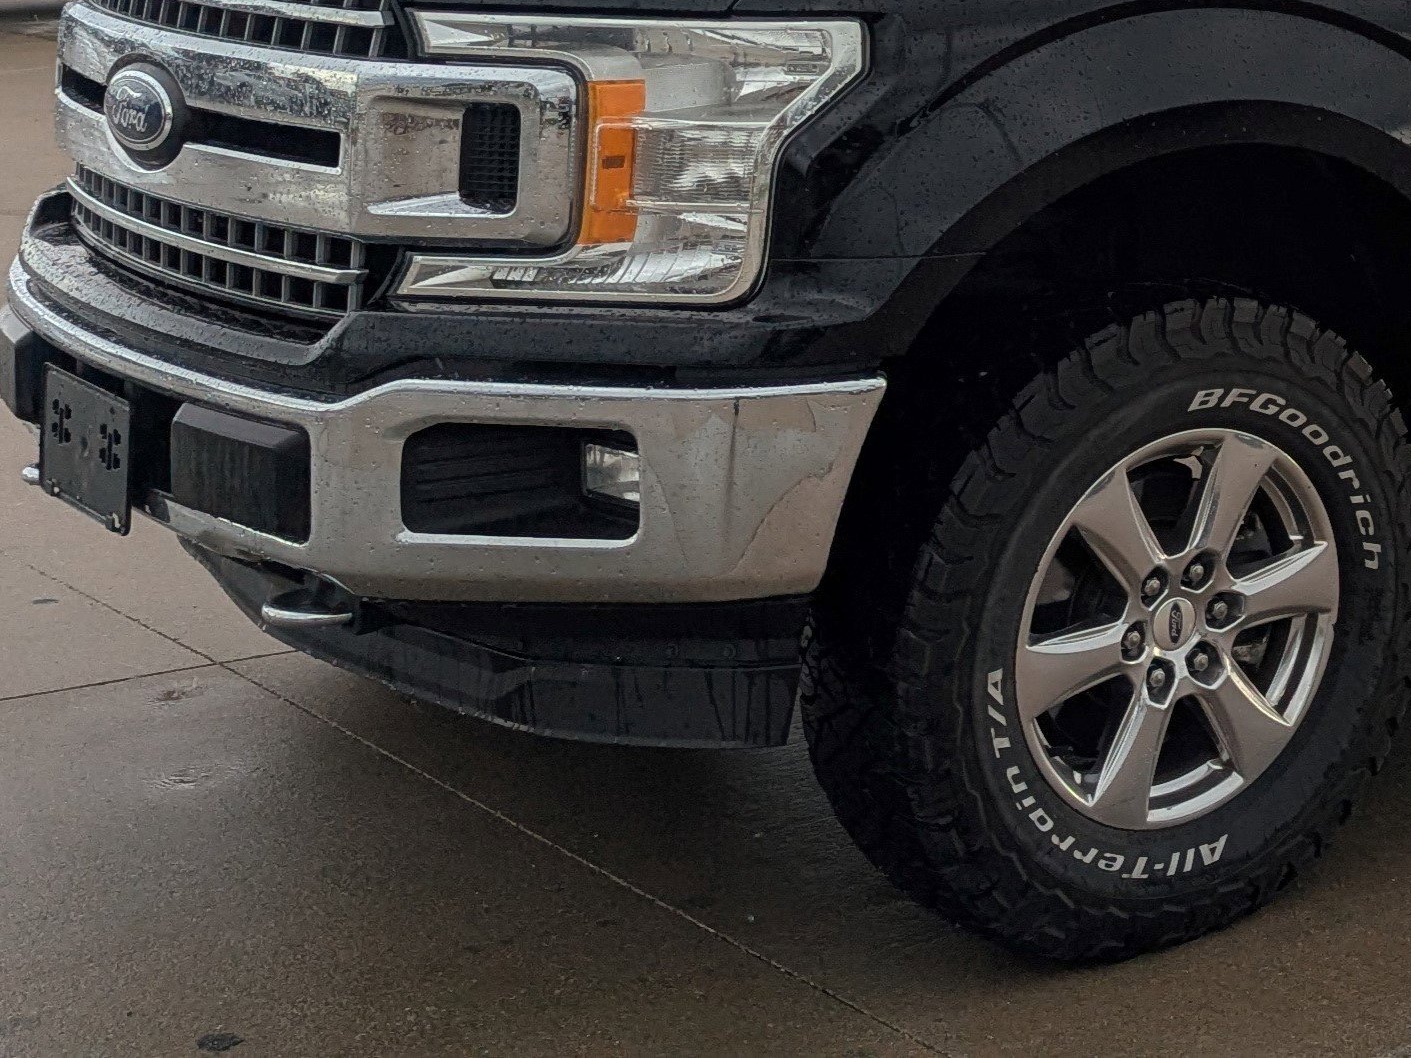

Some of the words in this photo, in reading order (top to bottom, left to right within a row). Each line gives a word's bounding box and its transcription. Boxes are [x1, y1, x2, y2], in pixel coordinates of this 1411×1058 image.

[112, 85, 148, 133] Ford
[1187, 388, 1382, 570] BFGoodrich
[987, 668, 1012, 759] T/A
[1006, 765, 1229, 879] All-Terrain
